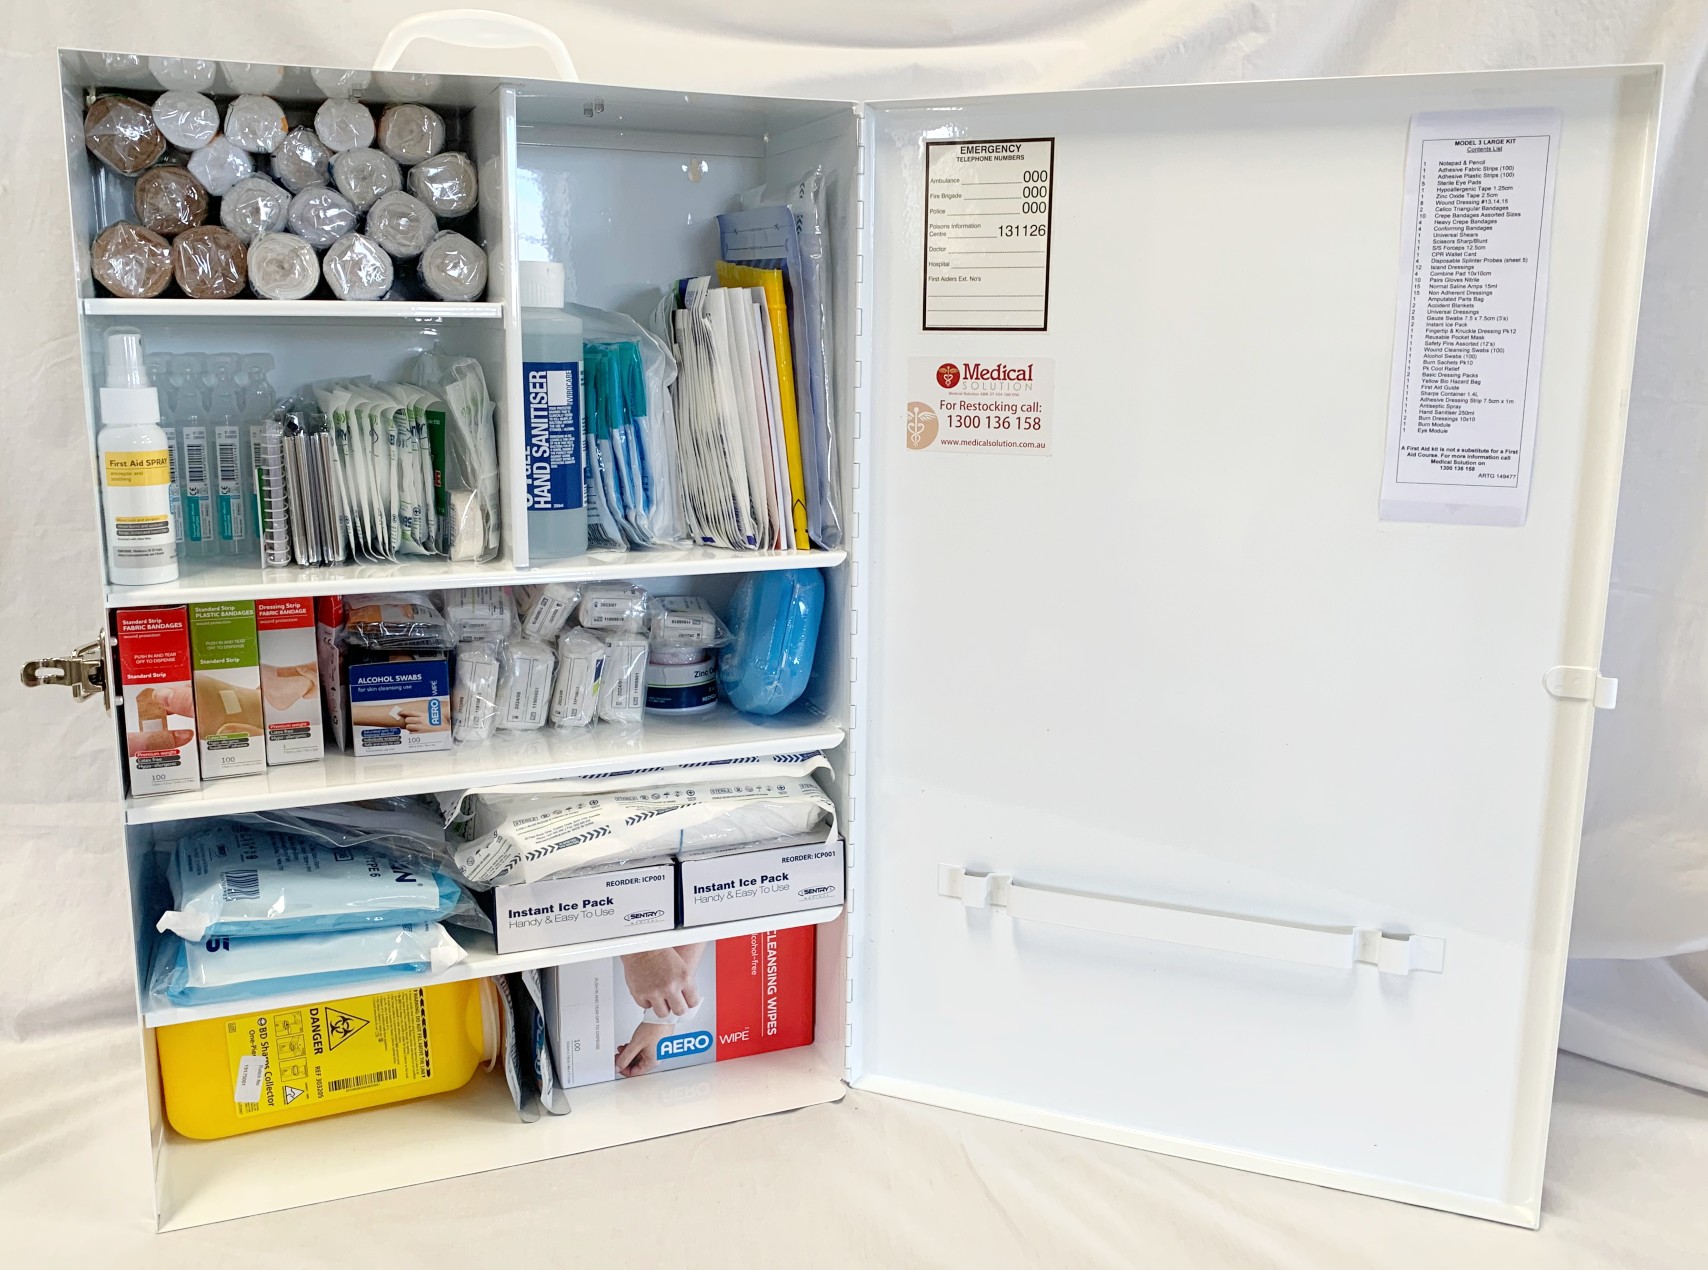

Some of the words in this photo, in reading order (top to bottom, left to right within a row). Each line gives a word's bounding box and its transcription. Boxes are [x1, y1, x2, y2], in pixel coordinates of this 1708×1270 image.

[960, 144, 1022, 155] EMERGENCY
[1023, 170, 1048, 183] 000
[1022, 186, 1047, 199] 000
[1022, 201, 1047, 214] 000
[998, 224, 1046, 237] 131126
[963, 363, 1033, 382] Medical
[962, 381, 1033, 391] SOLUTION
[940, 400, 957, 410] For
[959, 400, 1017, 414] Restocking
[1020, 402, 1042, 413] call:
[529, 370, 550, 458] SANITISER
[947, 415, 980, 428] 1300
[986, 416, 1010, 429] 136
[1016, 417, 1041, 431] 158
[940, 438, 1046, 449] www.medicalsolution.com.au
[145, 458, 167, 466] SPRAY
[533, 462, 551, 509] HAND
[147, 622, 182, 630] BANDAGES
[358, 676, 394, 684] ALCOHOL
[694, 670, 708, 678] Zinc
[431, 700, 439, 724] AERO
[781, 854, 814, 863] REORDER:
[814, 851, 836, 859] ICP001
[606, 877, 641, 887] REORDER:
[642, 874, 665, 883] ICP001
[694, 880, 735, 894] Instant
[739, 877, 757, 887] Ice
[760, 872, 789, 884] Pack
[694, 893, 724, 904] Handy
[727, 890, 734, 899] &
[735, 887, 757, 899] Easy
[760, 886, 770, 894] To
[771, 883, 790, 892] Use
[804, 886, 829, 895] SENTRY
[508, 905, 554, 919] Instant
[558, 902, 578, 912] Ice
[582, 897, 614, 909] Pack
[509, 918, 542, 929] Handy
[545, 915, 553, 924] &
[555, 912, 579, 923] Easy
[581, 910, 593, 919] To
[595, 908, 615, 916] Use
[630, 911, 658, 920] SENTRY
[766, 997, 778, 1036] WIPES
[309, 1008, 323, 1055] DANGER
[660, 1035, 710, 1056] AERO
[719, 1030, 749, 1044] WIPE
[259, 1027, 268, 1040] BD
[264, 1071, 275, 1107] Collector
